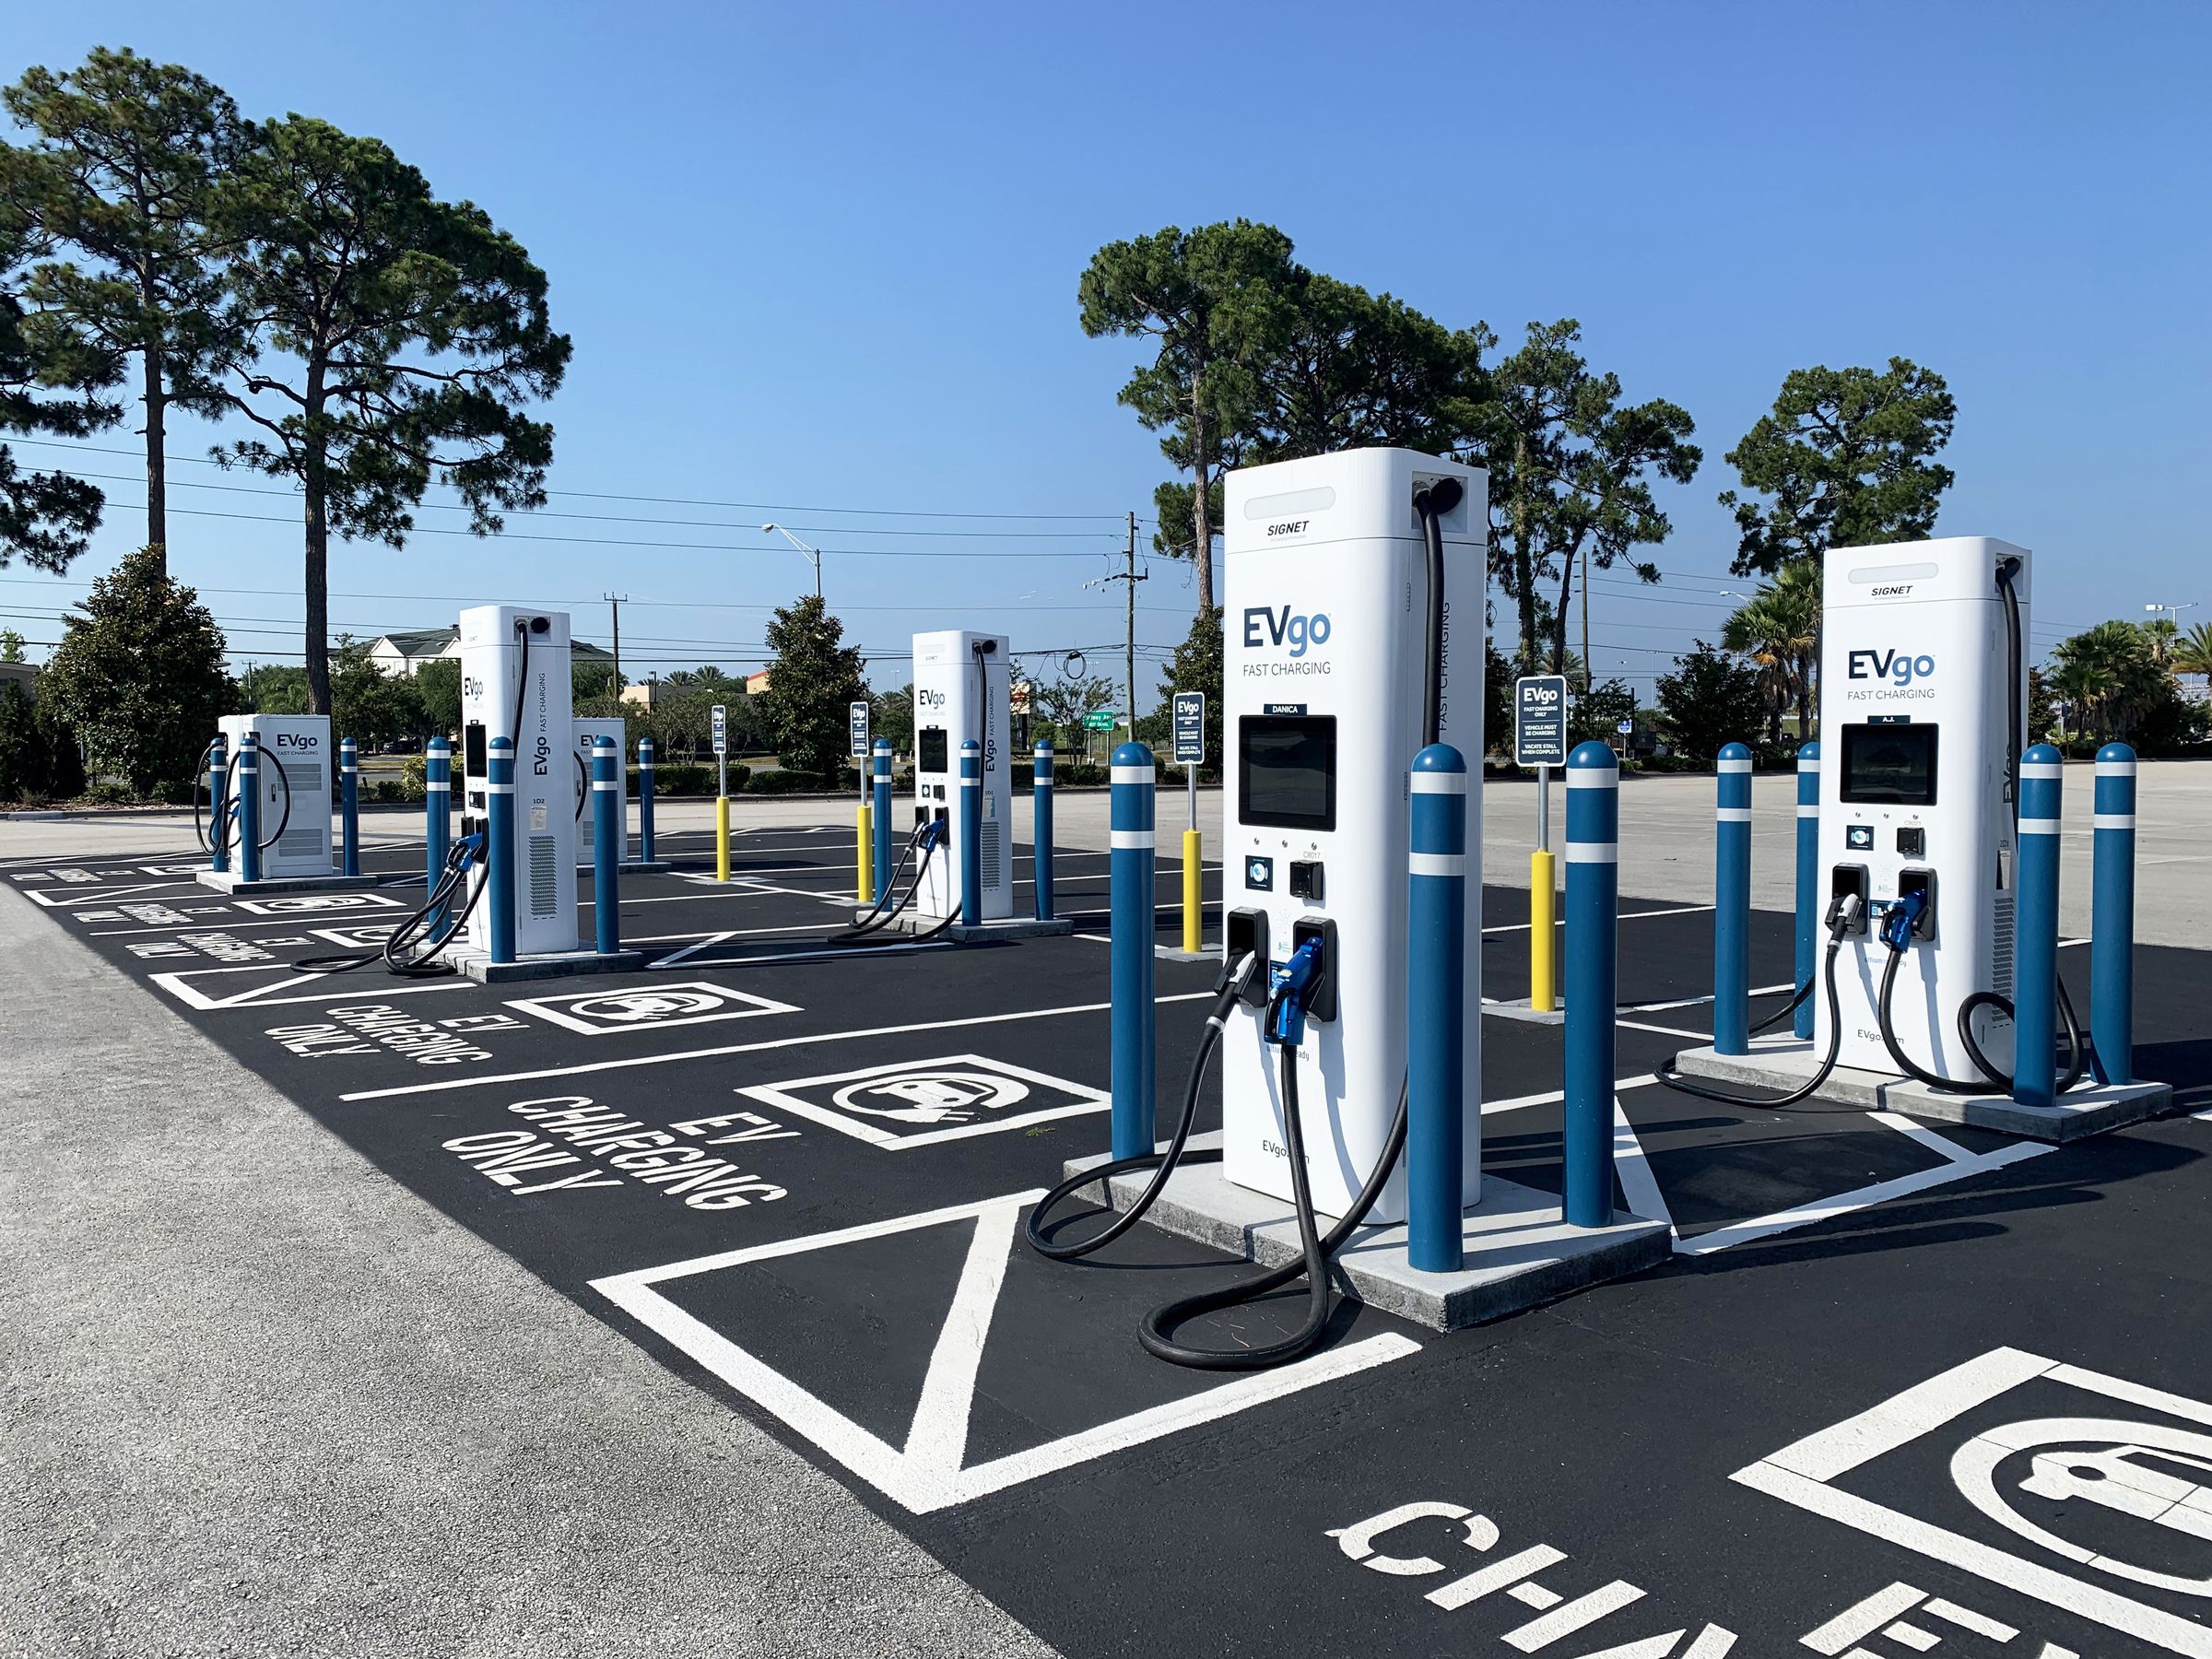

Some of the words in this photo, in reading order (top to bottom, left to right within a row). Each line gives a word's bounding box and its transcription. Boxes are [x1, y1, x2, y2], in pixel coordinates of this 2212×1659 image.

[1267, 521, 1310, 535] SIGNET
[1871, 585, 1913, 596] SIGNET
[1244, 605, 1331, 658] EVgo
[1243, 664, 1269, 677] FAST
[1271, 661, 1331, 676] CHARGING
[1849, 649, 1936, 687] EVgo
[465, 677, 483, 701] EVgo
[920, 689, 946, 710] EVgo
[1524, 688, 1558, 705] EVgo
[1848, 690, 1874, 700] FAST
[1876, 688, 1936, 700] CHARGING
[1178, 701, 1199, 715] EVgo
[1272, 705, 1298, 713] DANICA
[277, 734, 317, 750] EVgo
[534, 736, 551, 775] EVgo
[984, 739, 997, 772] EVgo
[438, 1013, 531, 1032] EV
[264, 1023, 382, 1058] ONLY
[325, 1005, 493, 1065] CHARGING
[667, 1112, 803, 1145] EV
[441, 1130, 625, 1195] ONLY
[507, 1096, 788, 1211] CHARGING
